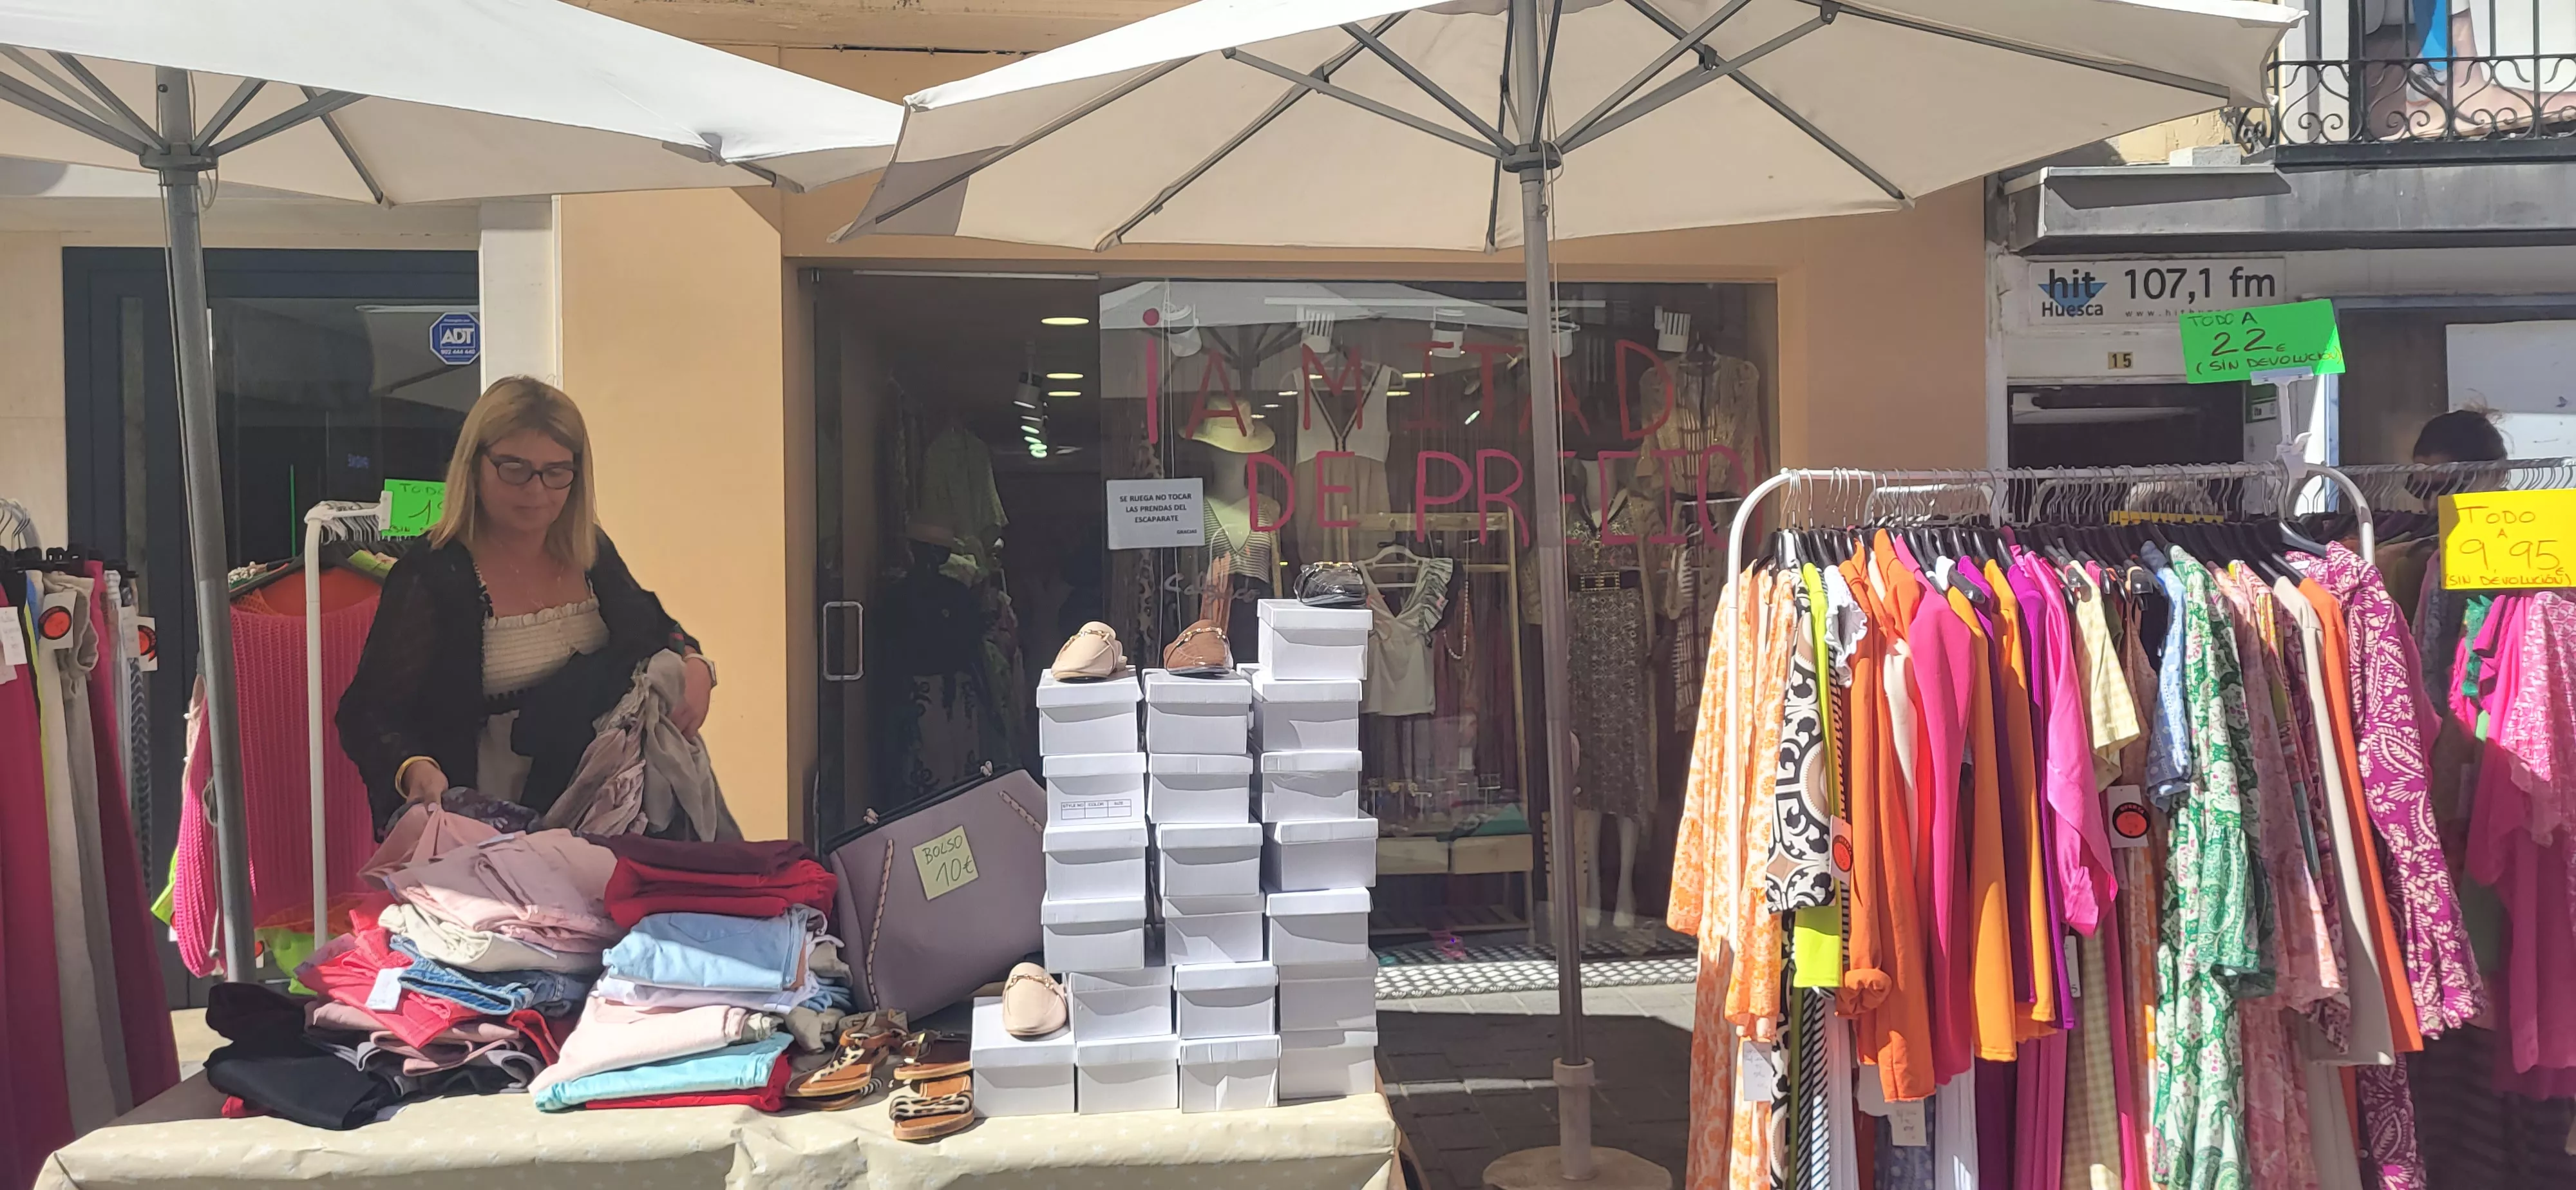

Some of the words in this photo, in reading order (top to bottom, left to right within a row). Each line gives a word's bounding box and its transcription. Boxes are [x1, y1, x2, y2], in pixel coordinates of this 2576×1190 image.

[2049, 268, 2096, 299] hit
[2125, 268, 2211, 305] 107,1
[2229, 266, 2276, 298] fm
[2041, 301, 2104, 317] Huesca
[2241, 311, 2259, 325] A
[440, 327, 475, 345] ADT
[2112, 353, 2132, 368] 15
[1302, 339, 1674, 441] MITAD
[1247, 451, 1359, 533] DE
[1135, 515, 1179, 524] ESCAPARATE
[2457, 506, 2535, 524] TODO
[2497, 528, 2508, 538] A
[922, 835, 963, 865] BOLSO
[935, 855, 974, 887] 10€
